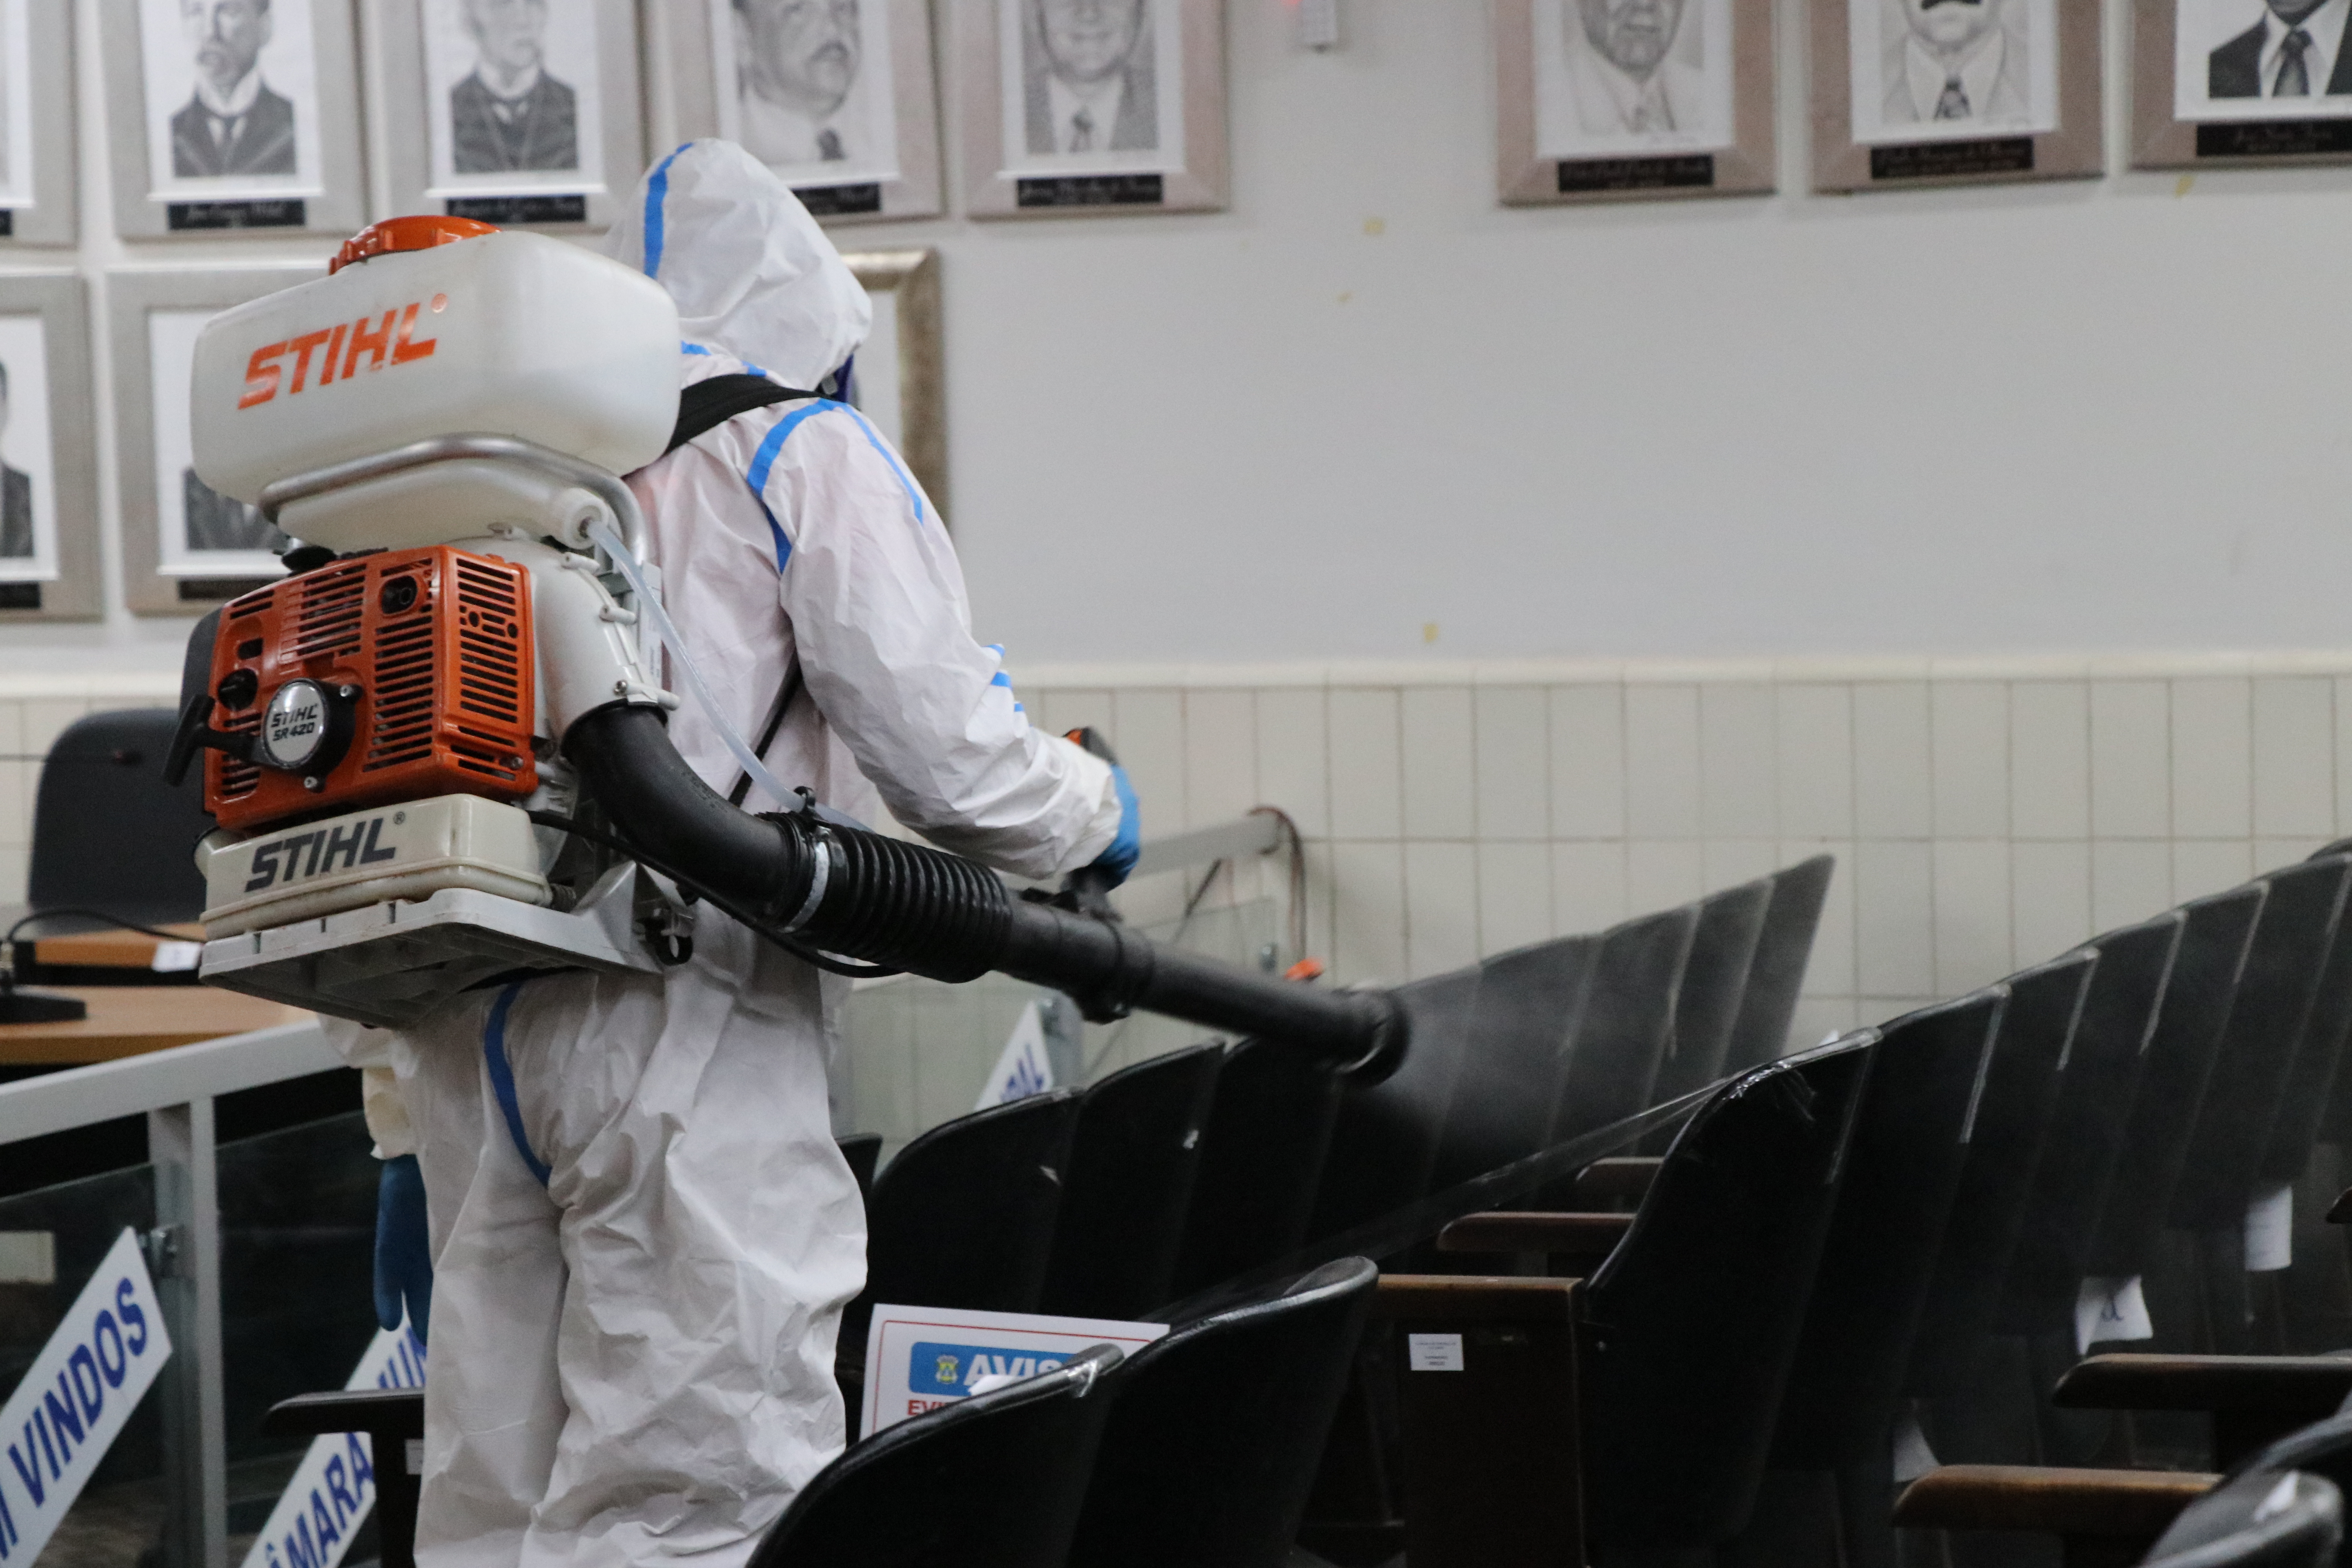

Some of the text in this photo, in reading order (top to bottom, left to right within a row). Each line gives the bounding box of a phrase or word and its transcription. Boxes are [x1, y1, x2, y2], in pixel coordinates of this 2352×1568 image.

[238, 303, 437, 409] STIHL
[271, 706, 317, 727] STIHL
[8, 1278, 147, 1508] VINDOS
[265, 1432, 373, 1568] MARA
